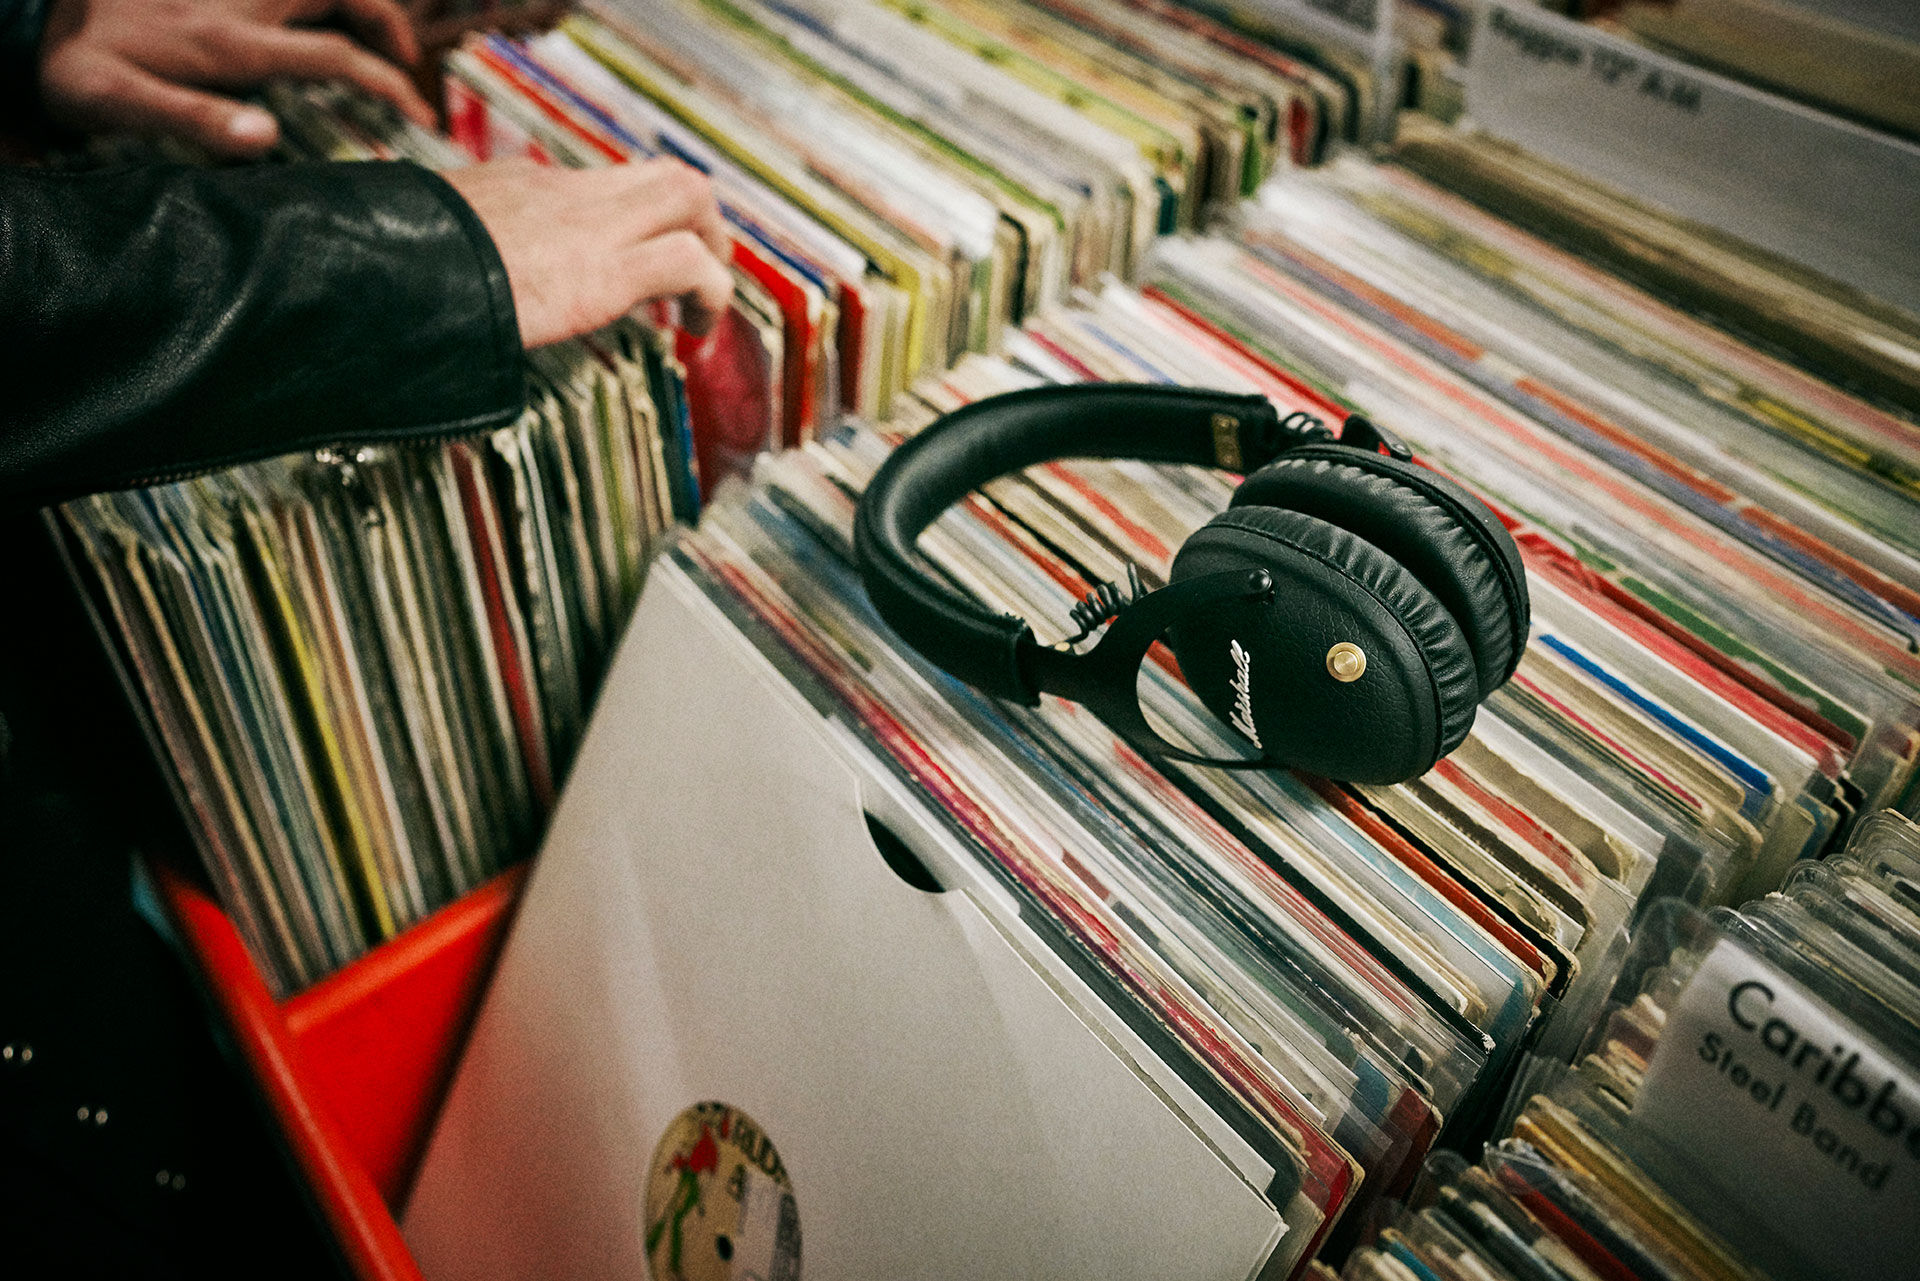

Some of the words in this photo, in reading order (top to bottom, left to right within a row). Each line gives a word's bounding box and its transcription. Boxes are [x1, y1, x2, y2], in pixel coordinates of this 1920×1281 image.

[1229, 639, 1263, 749] Marshall
[1697, 1030, 1787, 1112] Steel
[1790, 1102, 1893, 1190] Band
